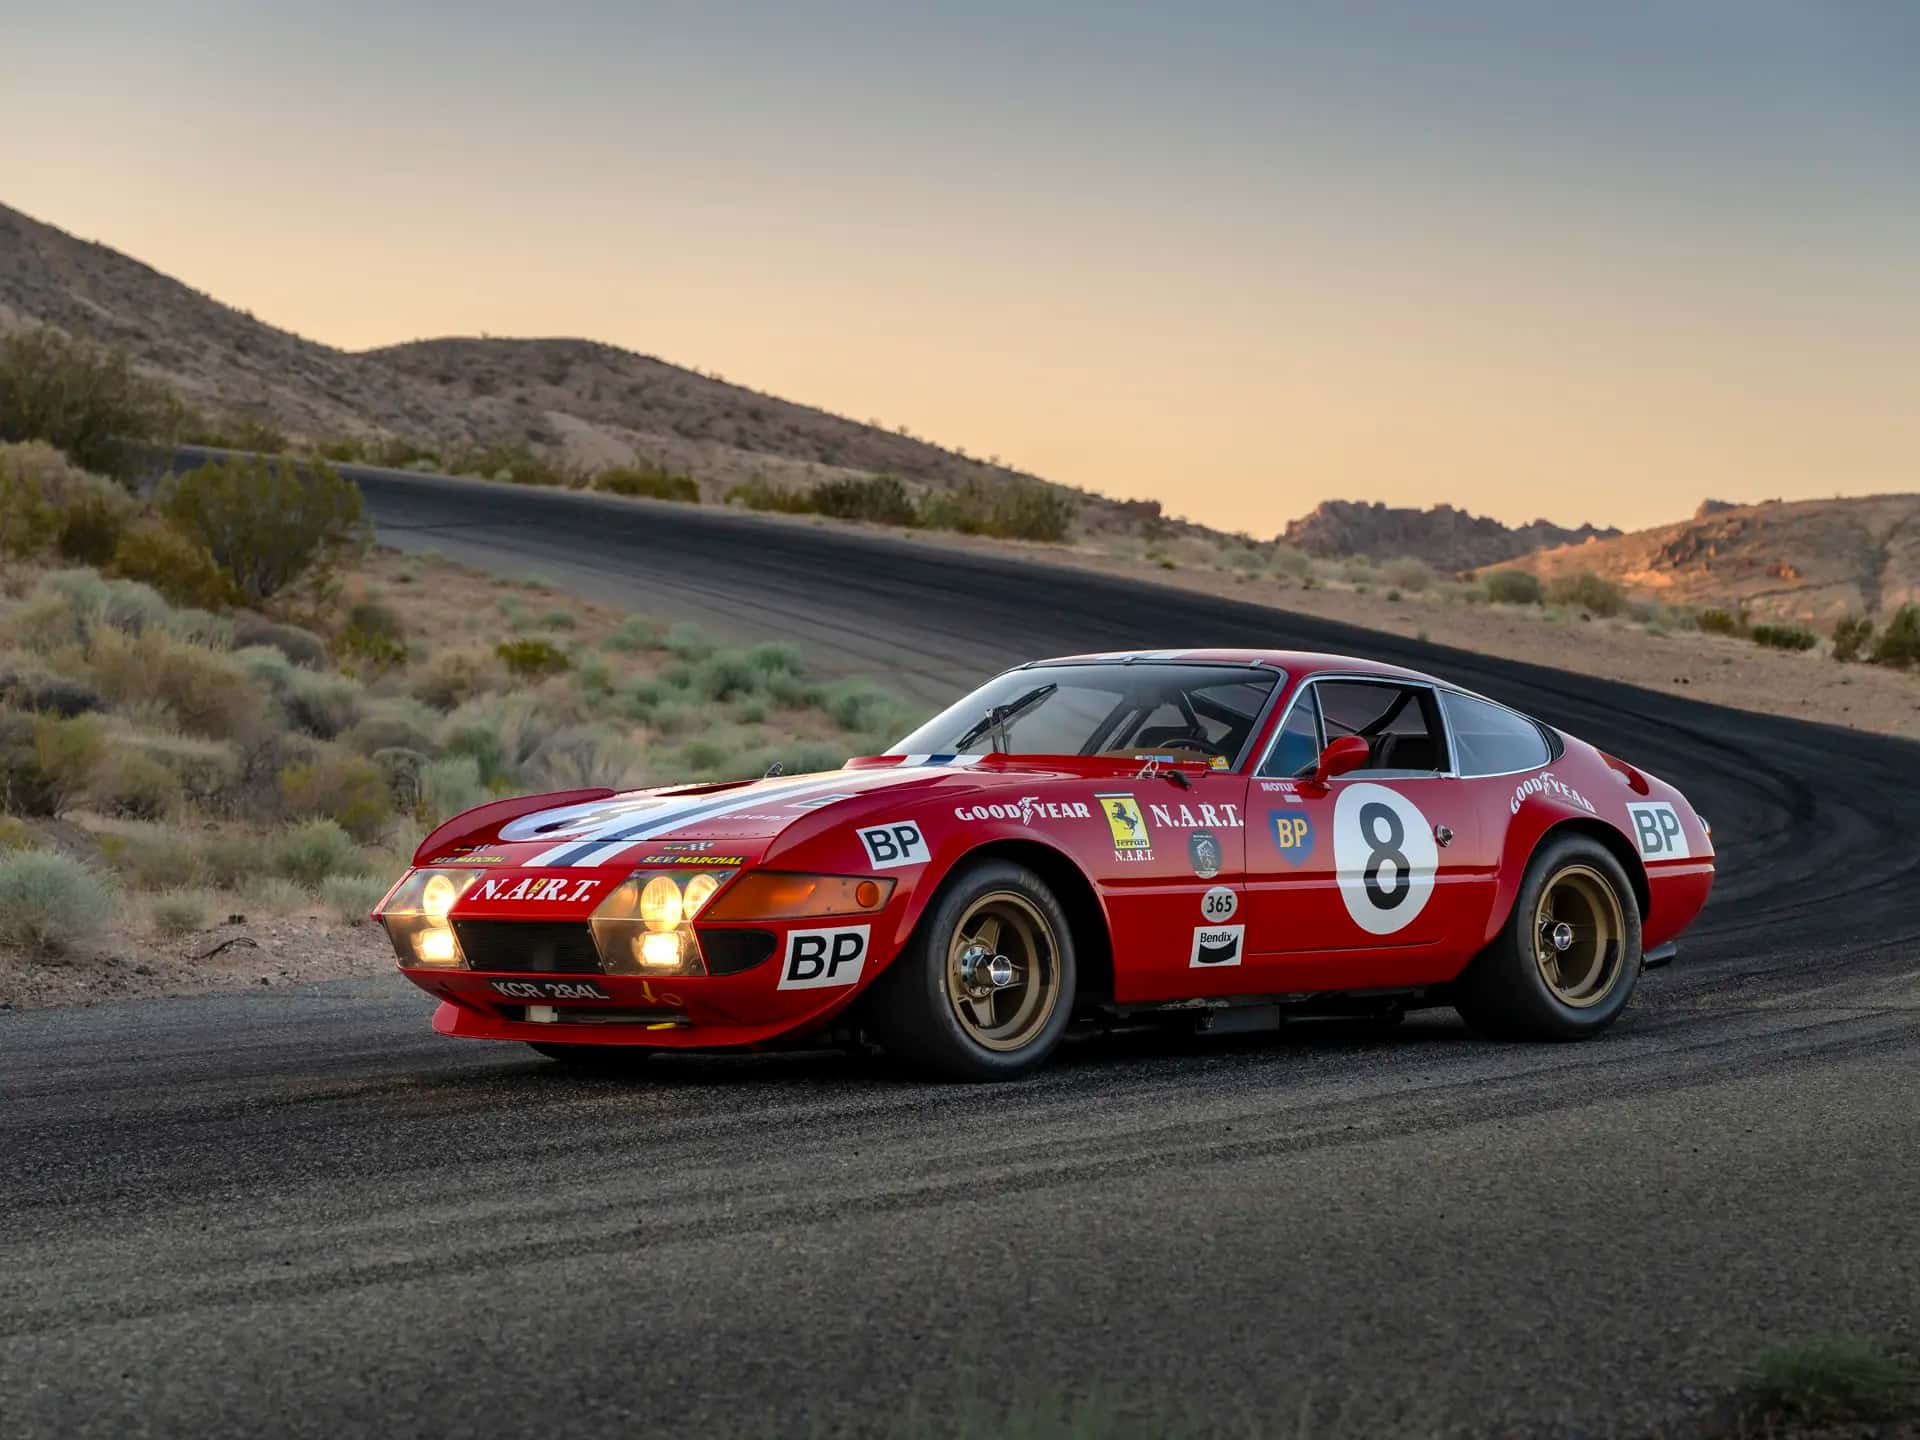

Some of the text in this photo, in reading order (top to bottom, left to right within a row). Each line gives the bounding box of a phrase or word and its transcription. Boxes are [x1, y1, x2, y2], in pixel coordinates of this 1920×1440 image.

[1260, 782, 1299, 792] MOTUL
[954, 800, 1092, 822] GOODYEAR
[1149, 803, 1244, 828] N.A.R.T.
[1276, 818, 1308, 848] BP
[1632, 809, 1680, 854] BP
[864, 825, 920, 863] BP
[1114, 849, 1155, 862] N.A.R.T.
[675, 856, 744, 865] MARCHAL
[1359, 802, 1411, 910] 8
[470, 878, 601, 902] N.A.R.T.
[1206, 895, 1233, 913] 365
[1200, 931, 1233, 943] Bendix
[787, 932, 865, 982] BP
[545, 983, 611, 1000] 284L
